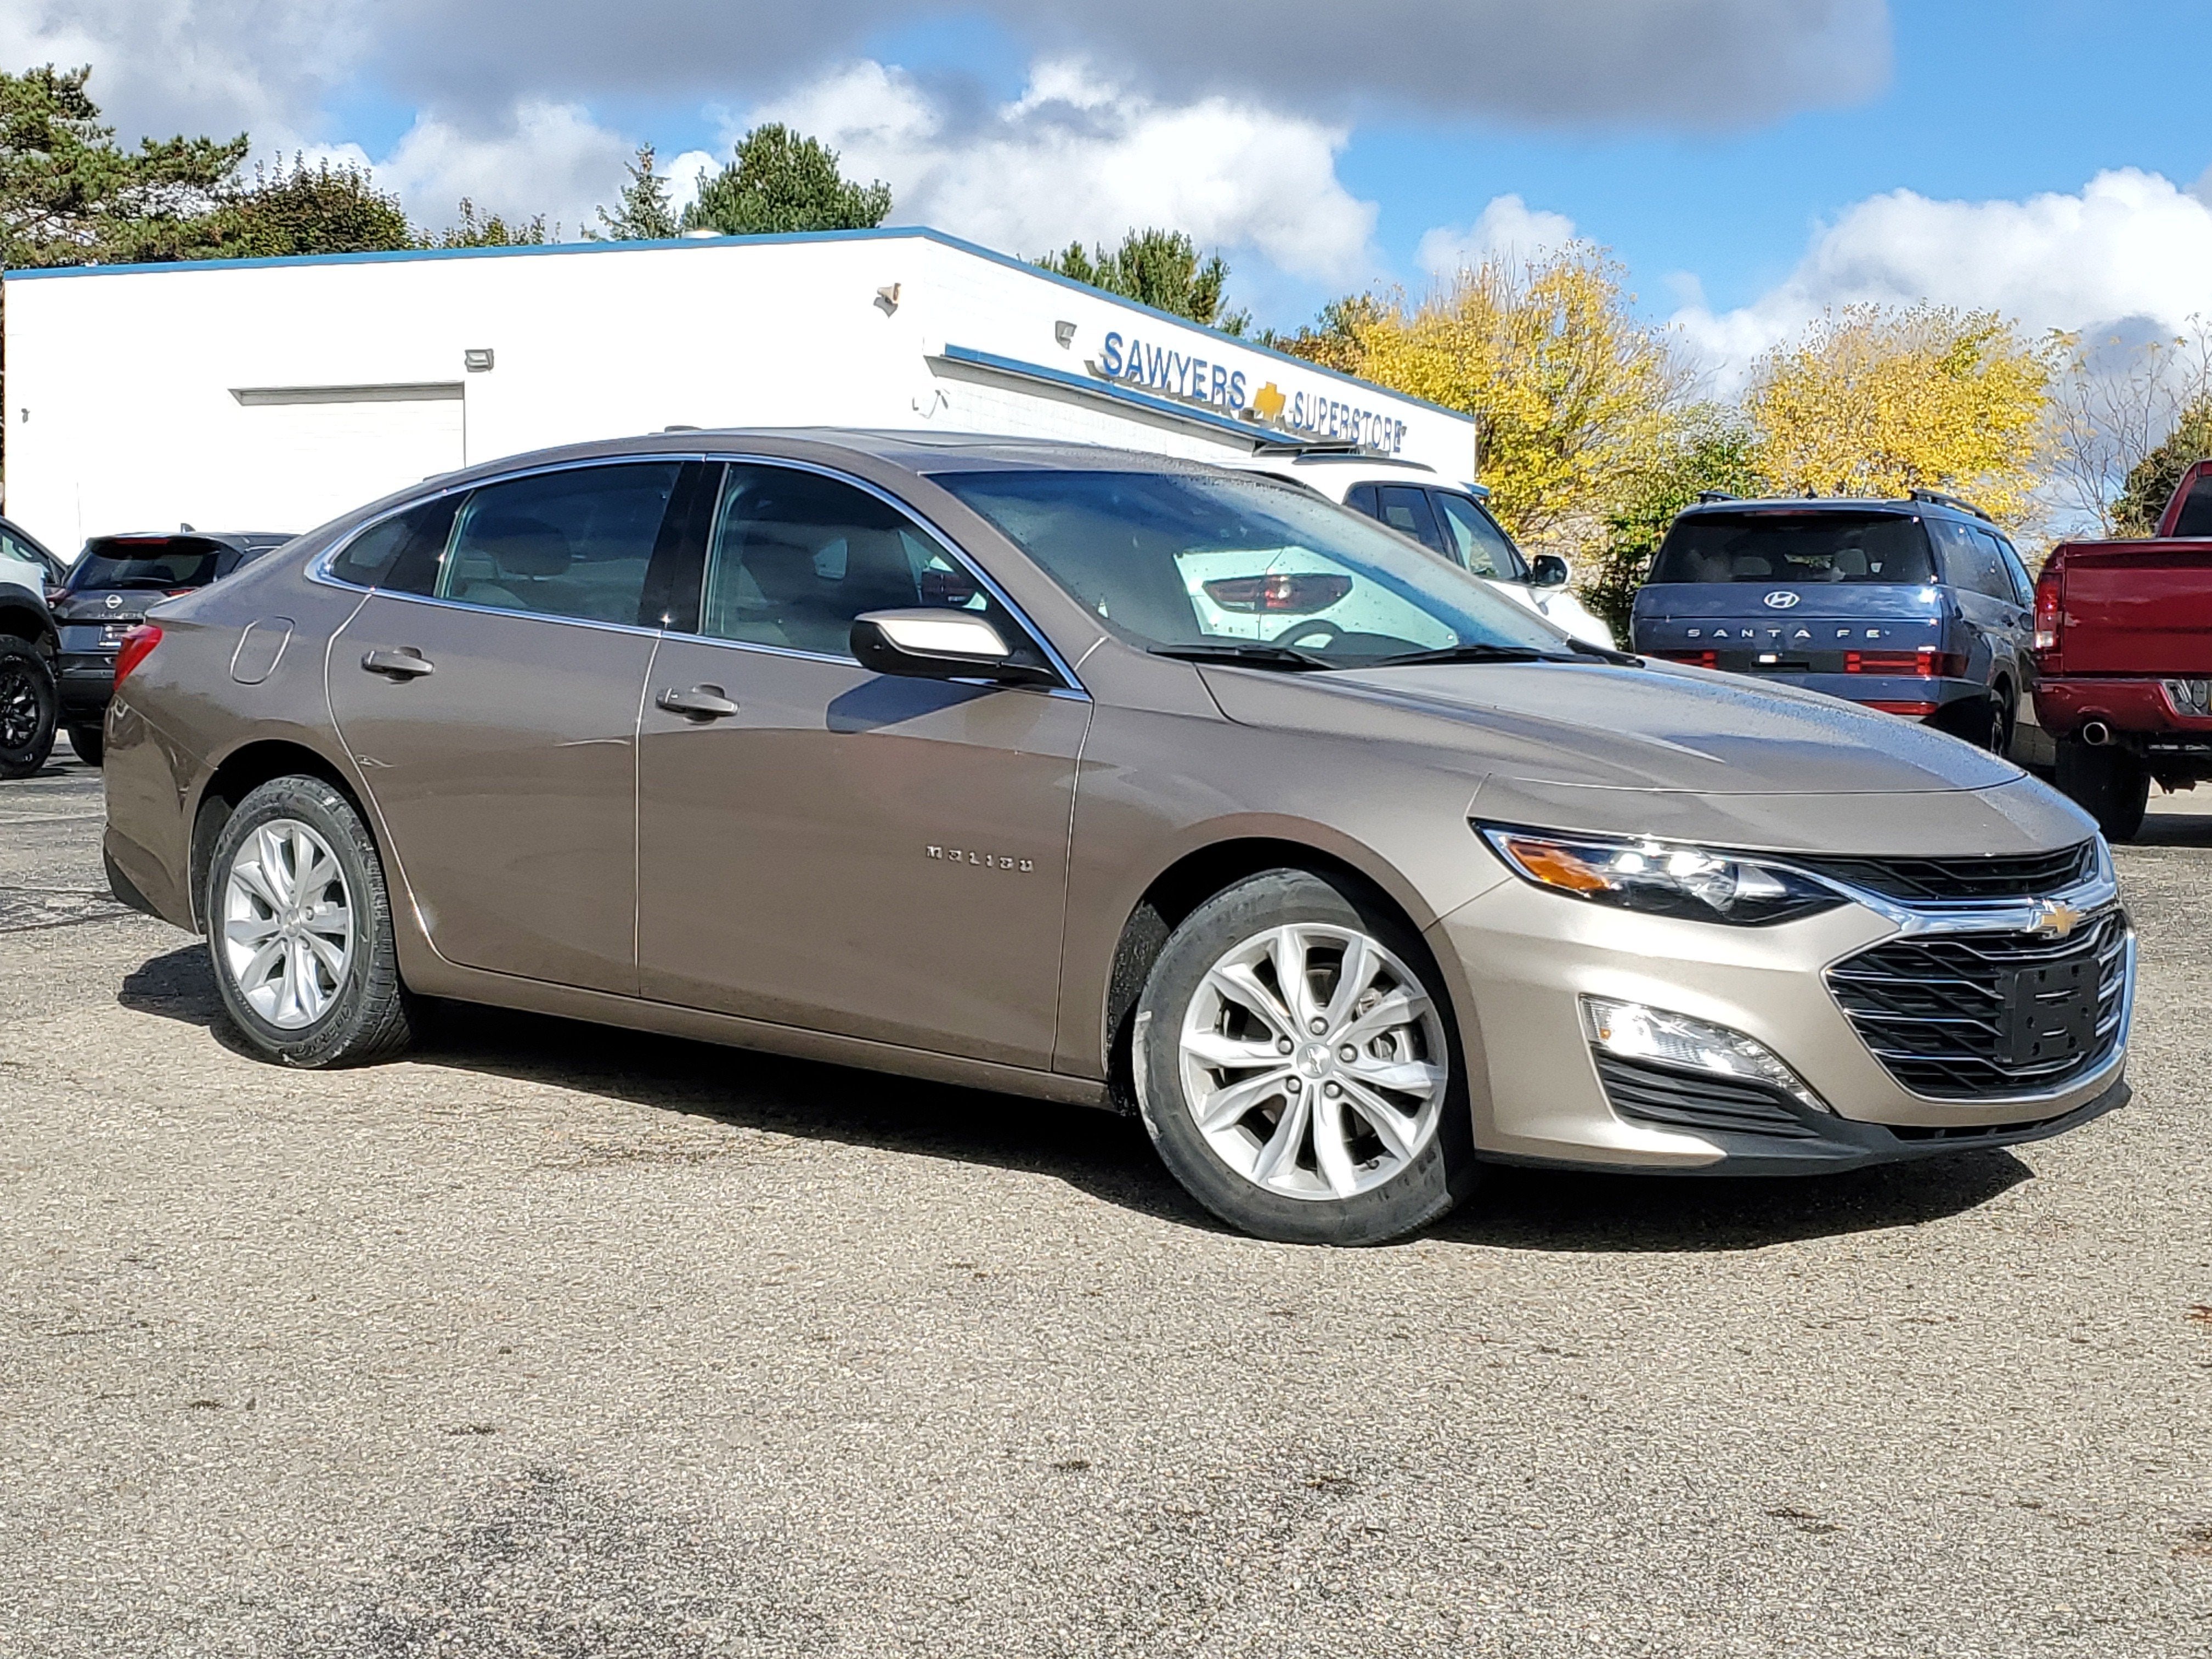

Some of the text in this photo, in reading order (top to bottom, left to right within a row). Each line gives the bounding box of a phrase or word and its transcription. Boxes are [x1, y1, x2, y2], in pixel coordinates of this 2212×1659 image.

[1103, 331, 1403, 453] SAWYERS SUPERSTORE
[1687, 628, 1880, 638] SANTA FE
[926, 845, 1034, 872] MALIBU
